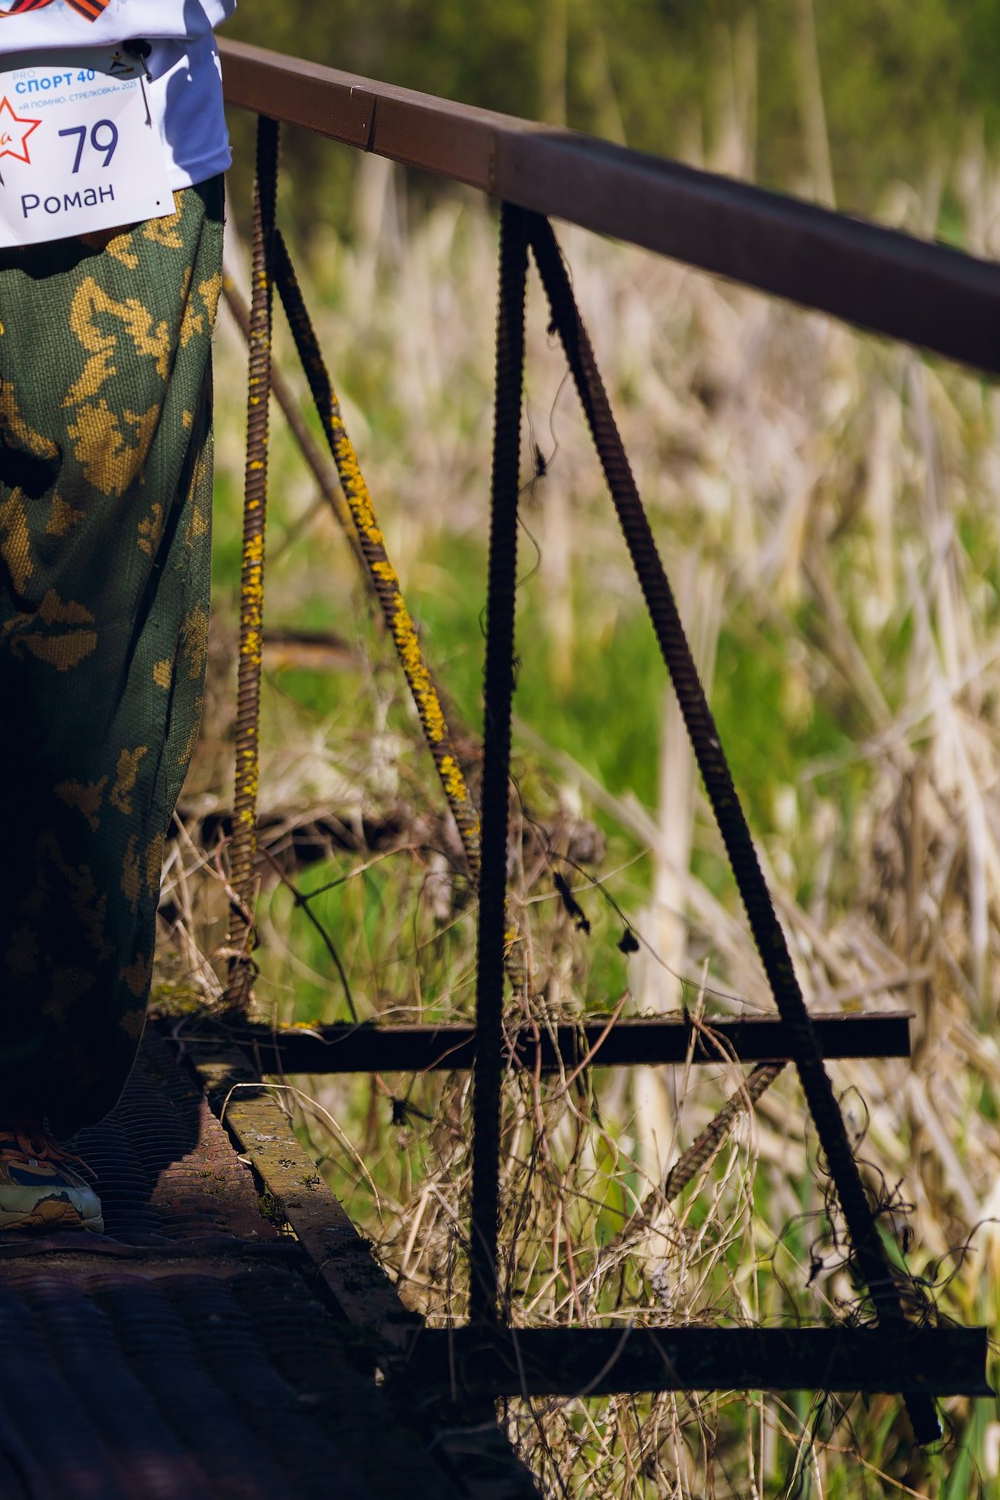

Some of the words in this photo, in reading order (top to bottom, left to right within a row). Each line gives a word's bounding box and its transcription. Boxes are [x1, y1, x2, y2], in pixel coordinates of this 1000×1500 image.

[15, 73, 73, 94] СПОРТ
[76, 68, 95, 83] 40
[121, 81, 138, 91] 2025
[58, 118, 119, 175] 79
[20, 183, 115, 218] Роман
